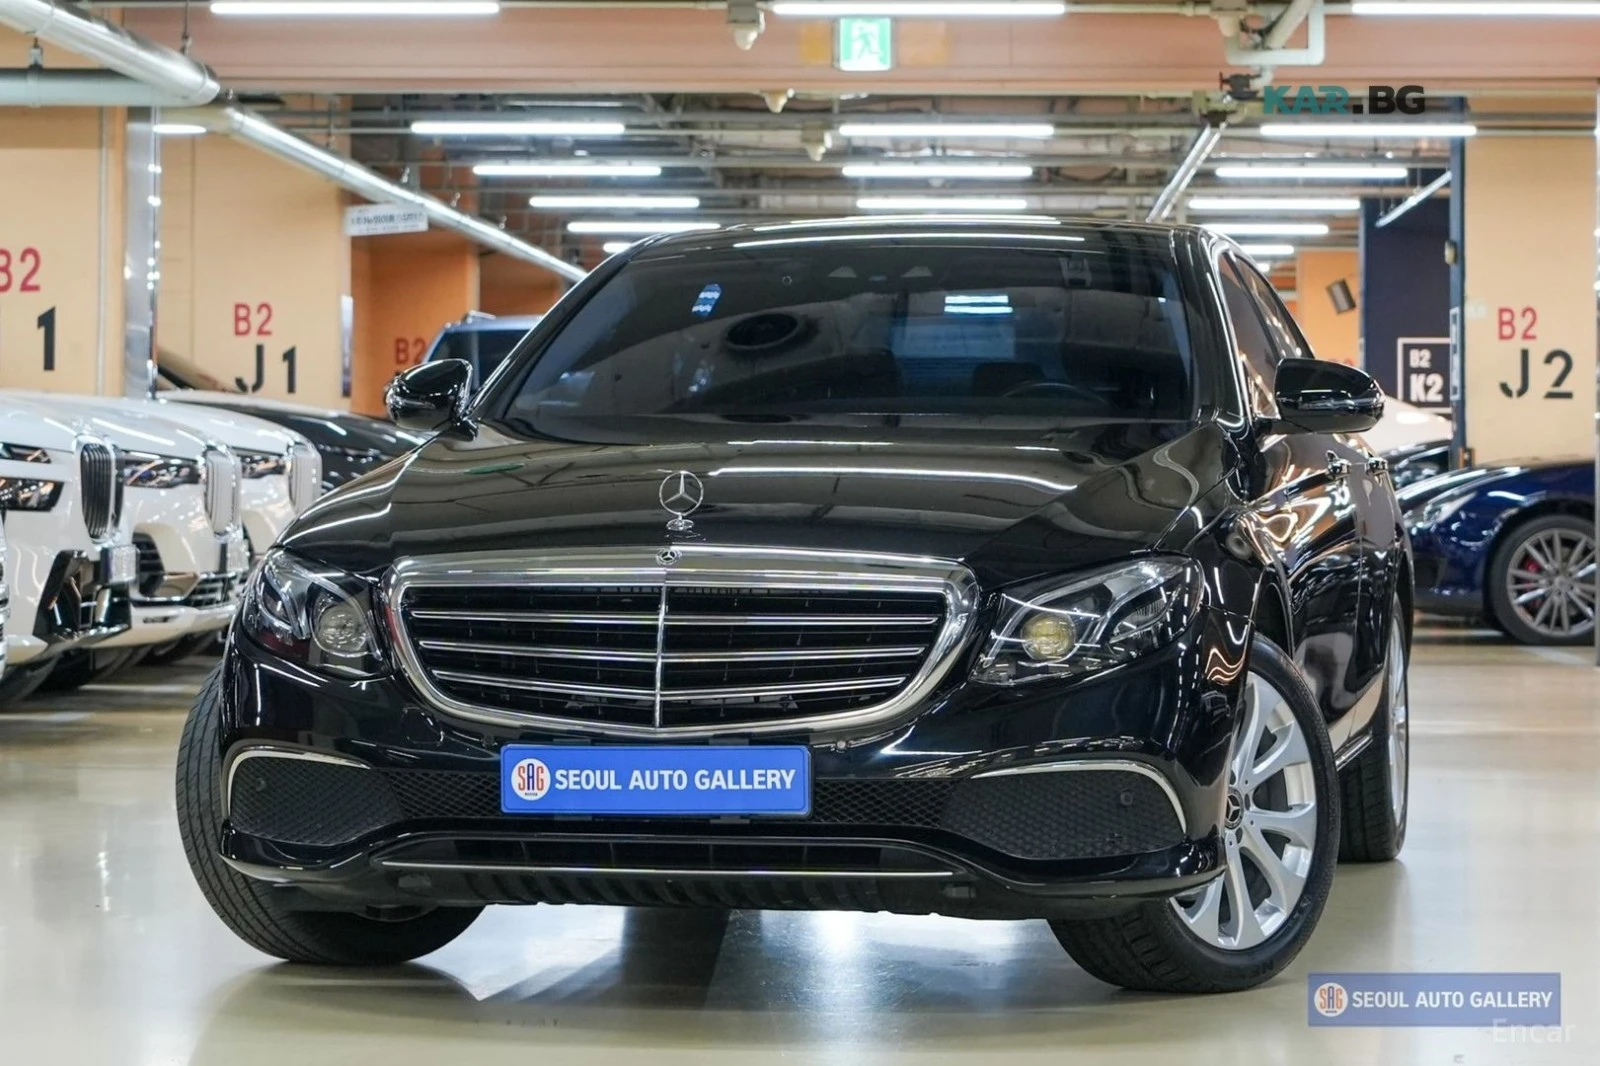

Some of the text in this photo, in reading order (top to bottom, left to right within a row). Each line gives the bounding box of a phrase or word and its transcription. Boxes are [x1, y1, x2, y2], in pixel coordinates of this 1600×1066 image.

[234, 303, 272, 336] B2
[1498, 307, 1538, 340] B2
[395, 337, 427, 366] B2
[1409, 373, 1445, 402] K2
[518, 763, 544, 792] SAG
[554, 769, 796, 791] SEOUL AUTO GALLERY
